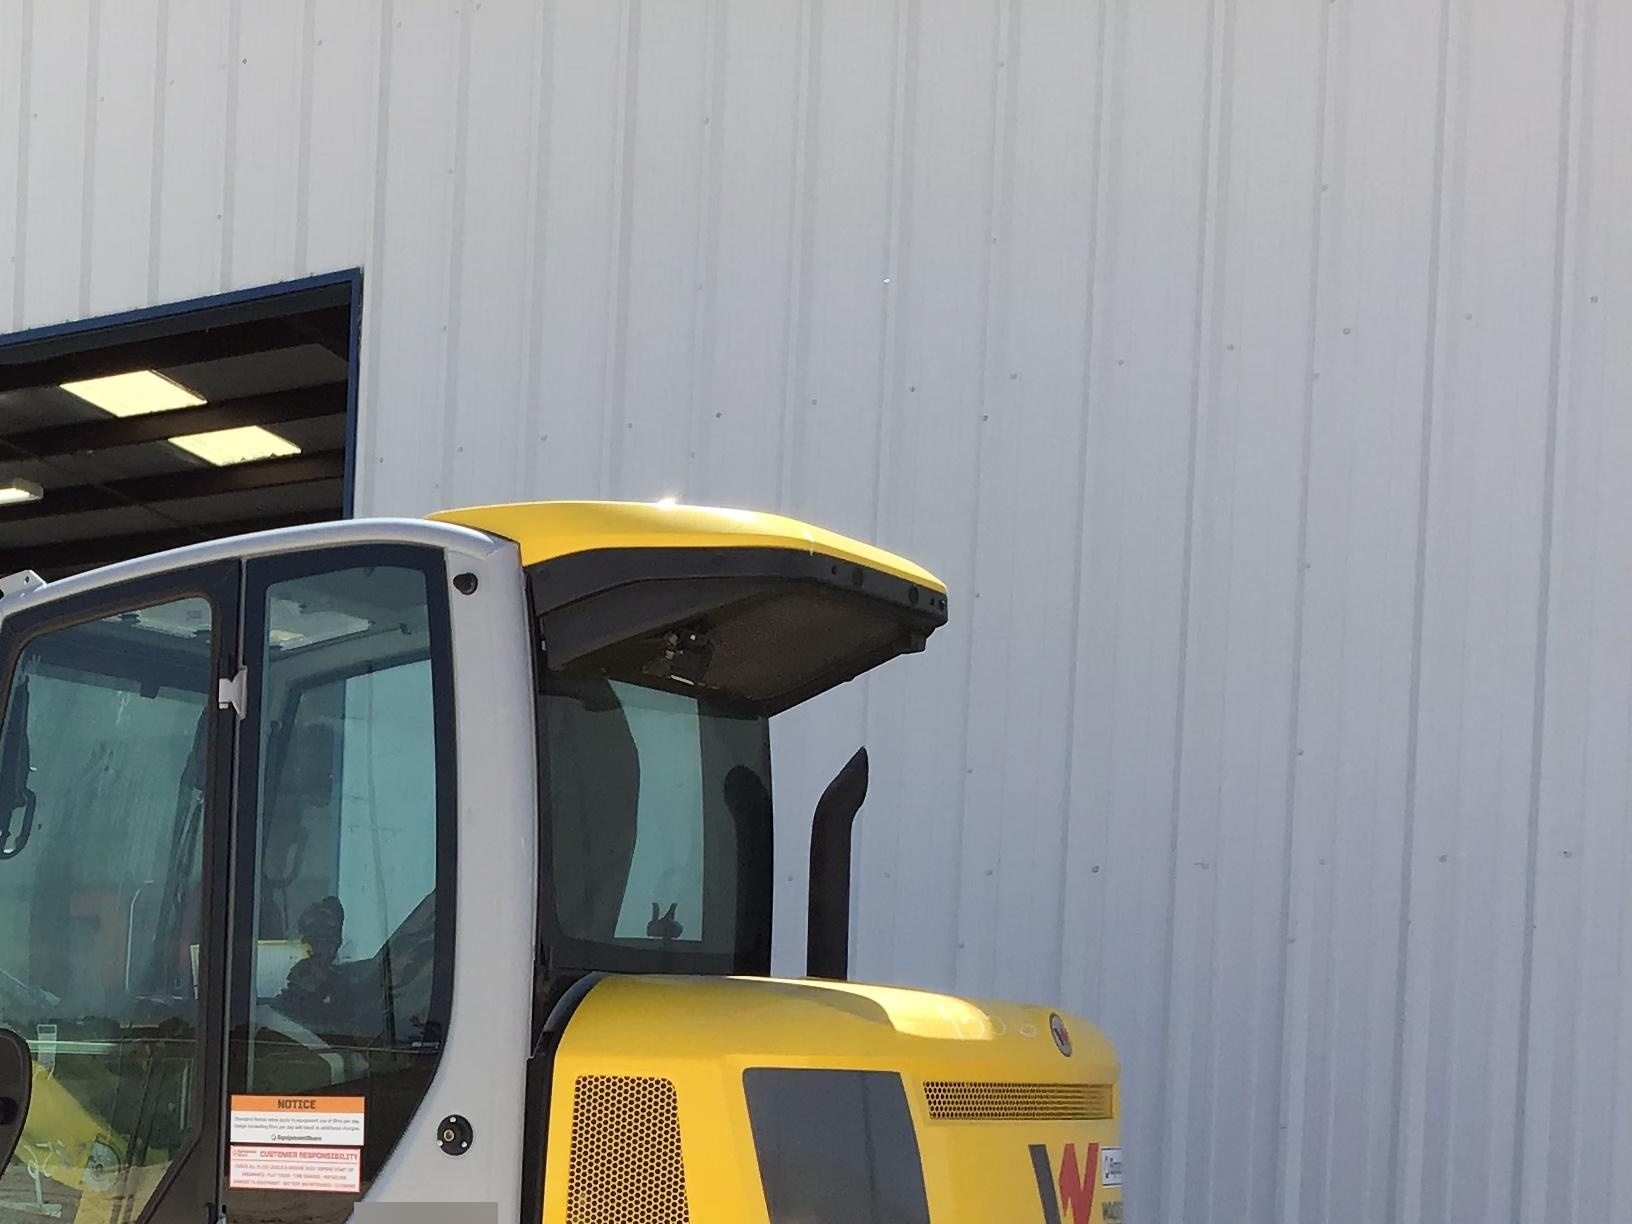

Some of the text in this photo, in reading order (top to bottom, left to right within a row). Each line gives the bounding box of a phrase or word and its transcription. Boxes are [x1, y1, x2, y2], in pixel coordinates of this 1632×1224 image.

[277, 1099, 317, 1109] NOTICE
[260, 1150, 298, 1159] CUSTOMER
[299, 1151, 358, 1161] RESPONSIBILITY
